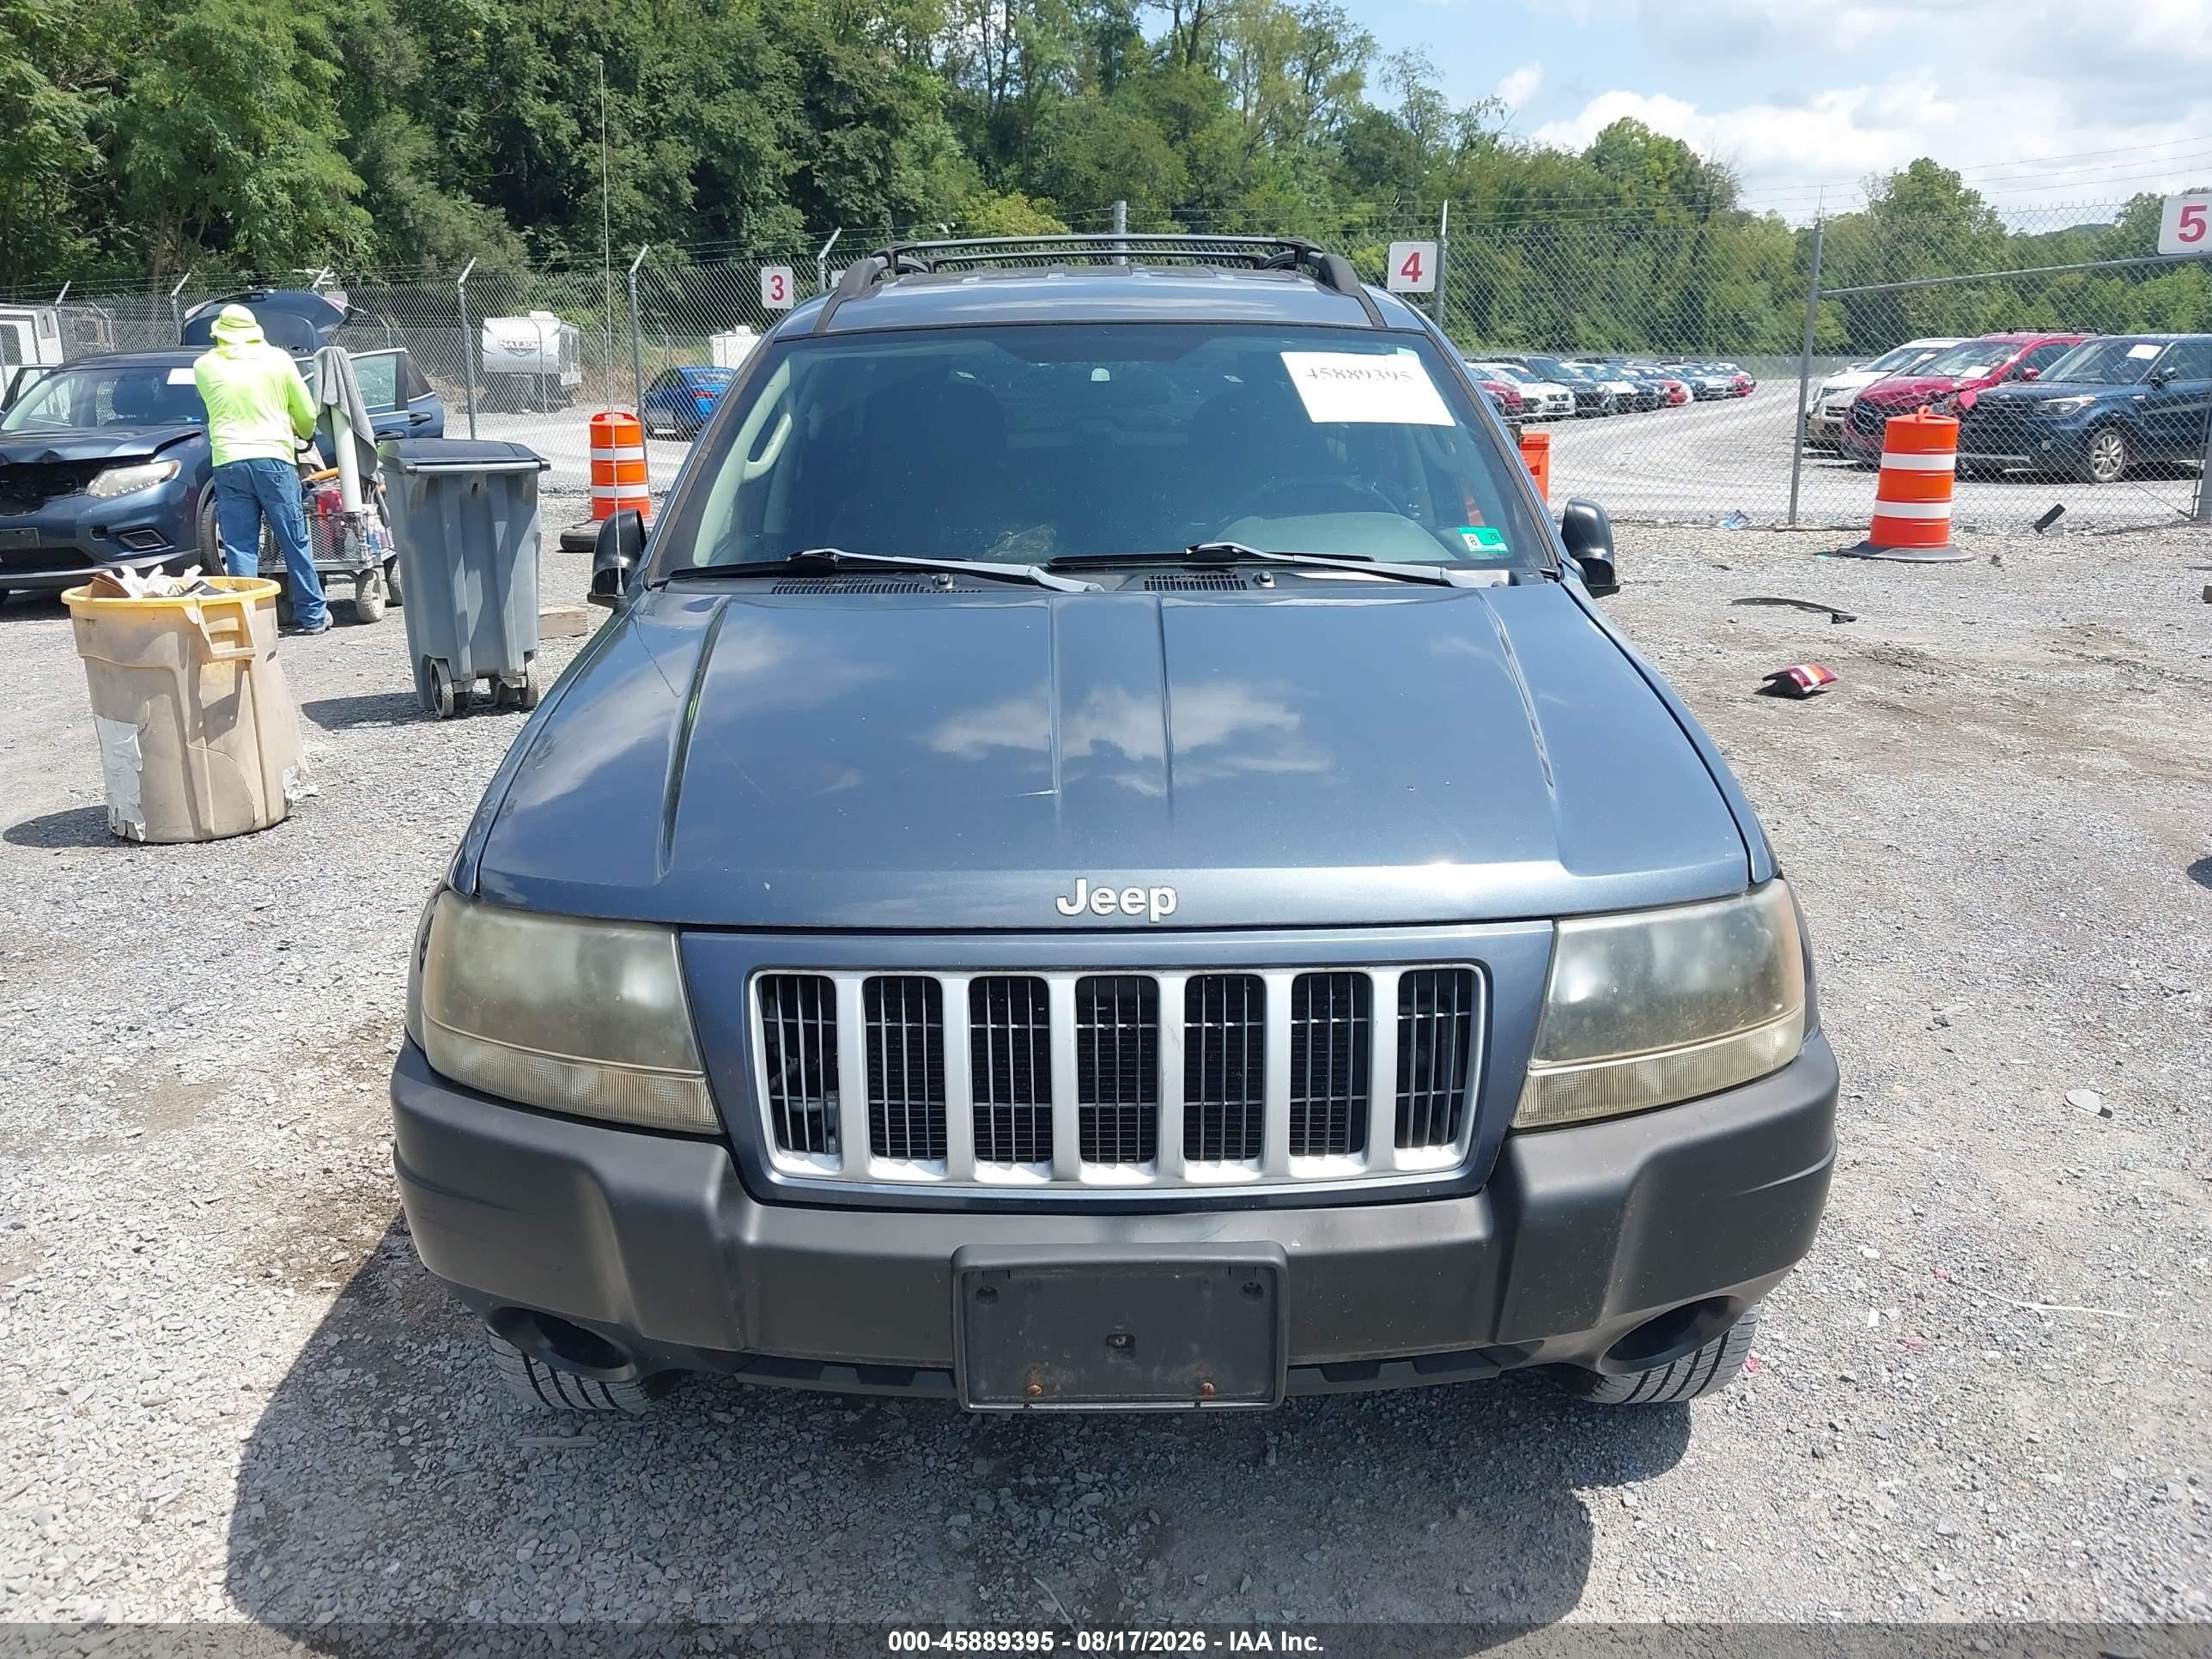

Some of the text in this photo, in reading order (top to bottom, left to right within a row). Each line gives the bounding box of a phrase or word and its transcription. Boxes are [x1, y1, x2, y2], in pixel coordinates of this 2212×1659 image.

[2179, 205, 2208, 242] 5
[1401, 252, 1422, 283] 4
[770, 275, 784, 301] 3
[42, 314, 50, 333] 1
[1306, 368, 1413, 382] 45889395
[1056, 878, 1177, 923] Jeep
